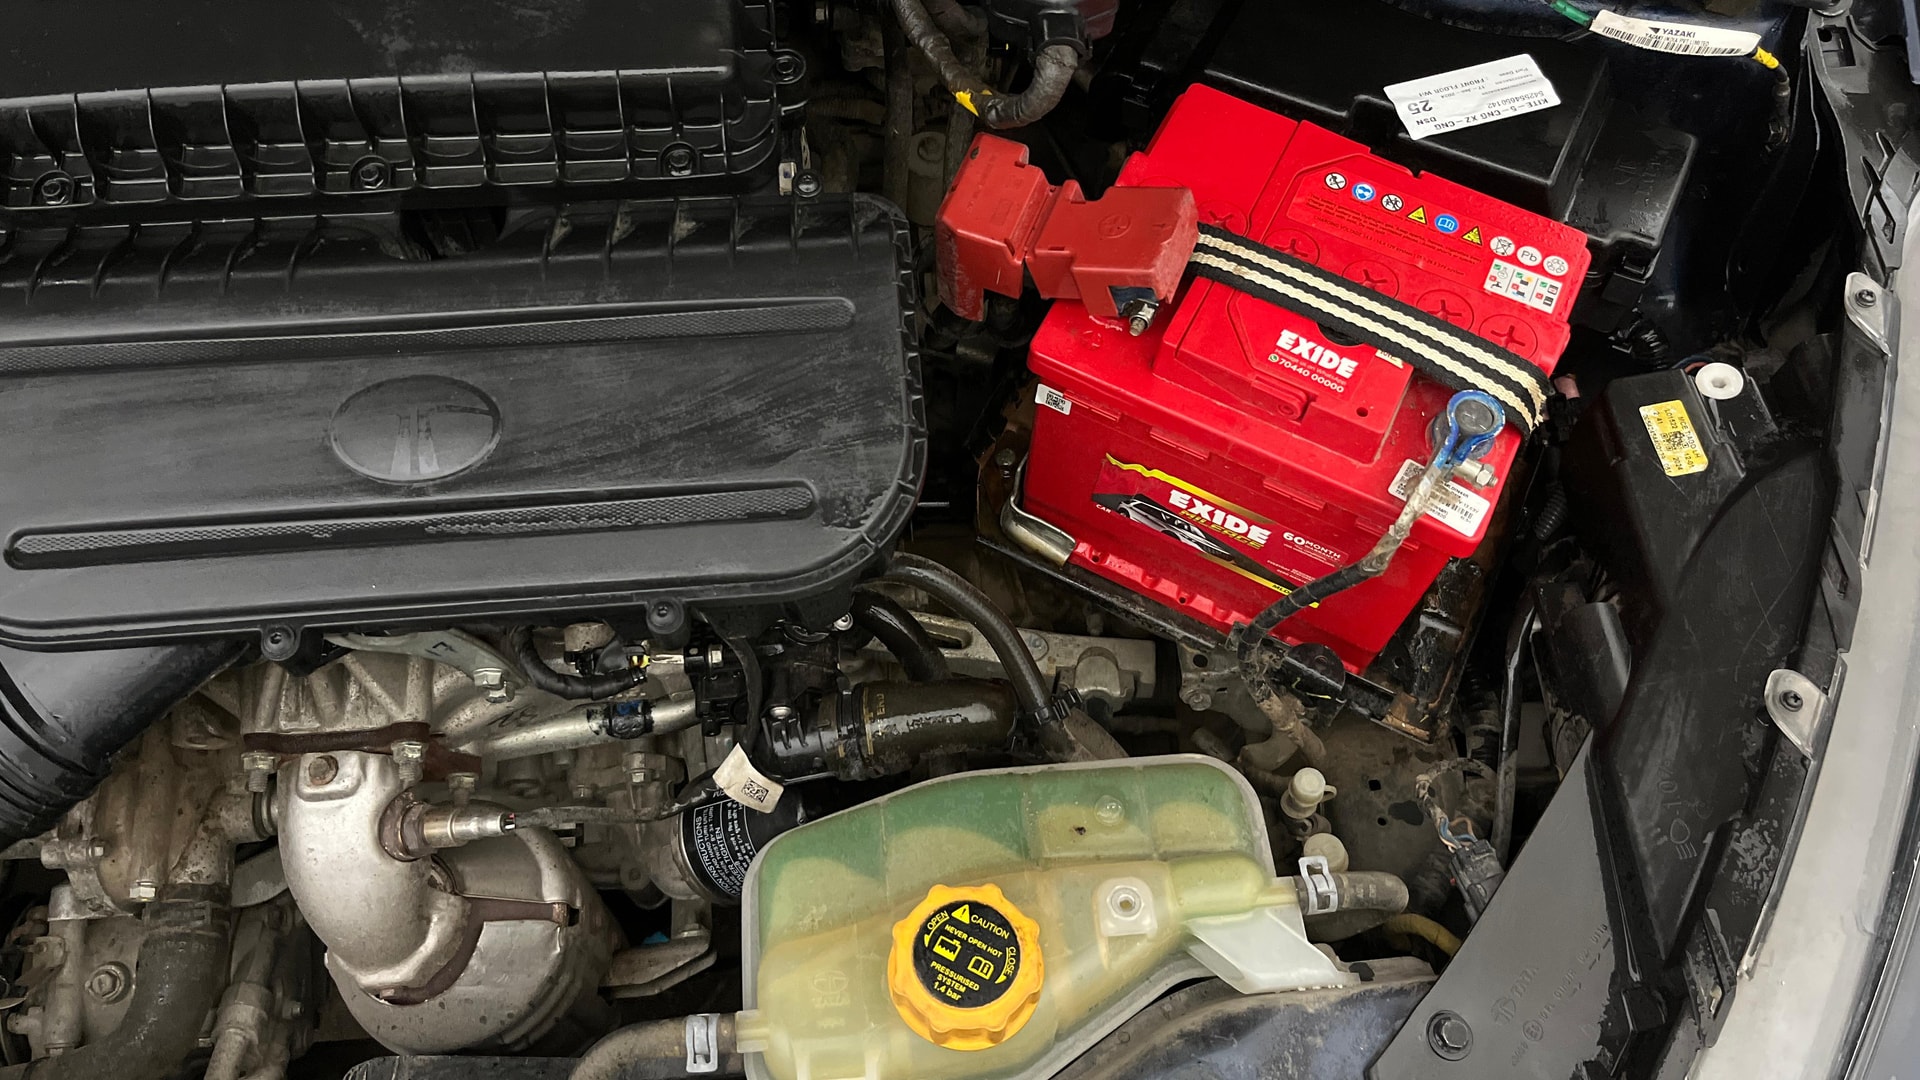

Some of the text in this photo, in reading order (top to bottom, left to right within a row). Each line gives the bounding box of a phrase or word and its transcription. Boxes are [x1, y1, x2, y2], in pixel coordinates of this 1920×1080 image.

[1661, 27, 1696, 38] YAZAKI
[1432, 82, 1458, 94] FLOOR
[1458, 76, 1485, 88] FRONT
[1405, 97, 1434, 116] 25
[1414, 115, 1437, 126] DSN
[1520, 249, 1537, 263] Pb
[1276, 329, 1358, 379] EXIDE
[1279, 358, 1344, 393] 70440 00000
[1095, 503, 1112, 514] CAR
[1168, 488, 1272, 545] EXIDE
[1178, 509, 1266, 551] MILEAGE
[1282, 531, 1306, 547] 60
[1304, 540, 1342, 560] MONTH
[696, 816, 718, 878] INSTRUCTIONS
[711, 842, 722, 860] TWIST
[715, 826, 730, 863] TIGHTEN
[711, 857, 720, 869] AND
[926, 910, 949, 931] OPEN
[970, 914, 1011, 940] CAUTION
[944, 924, 1003, 959] NEVER OPEN HOT
[1006, 946, 1017, 977] CLOSE
[930, 960, 980, 992] PRESSURISED
[936, 973, 967, 993] SYSTEM
[933, 981, 962, 1001] 1.4 bar
